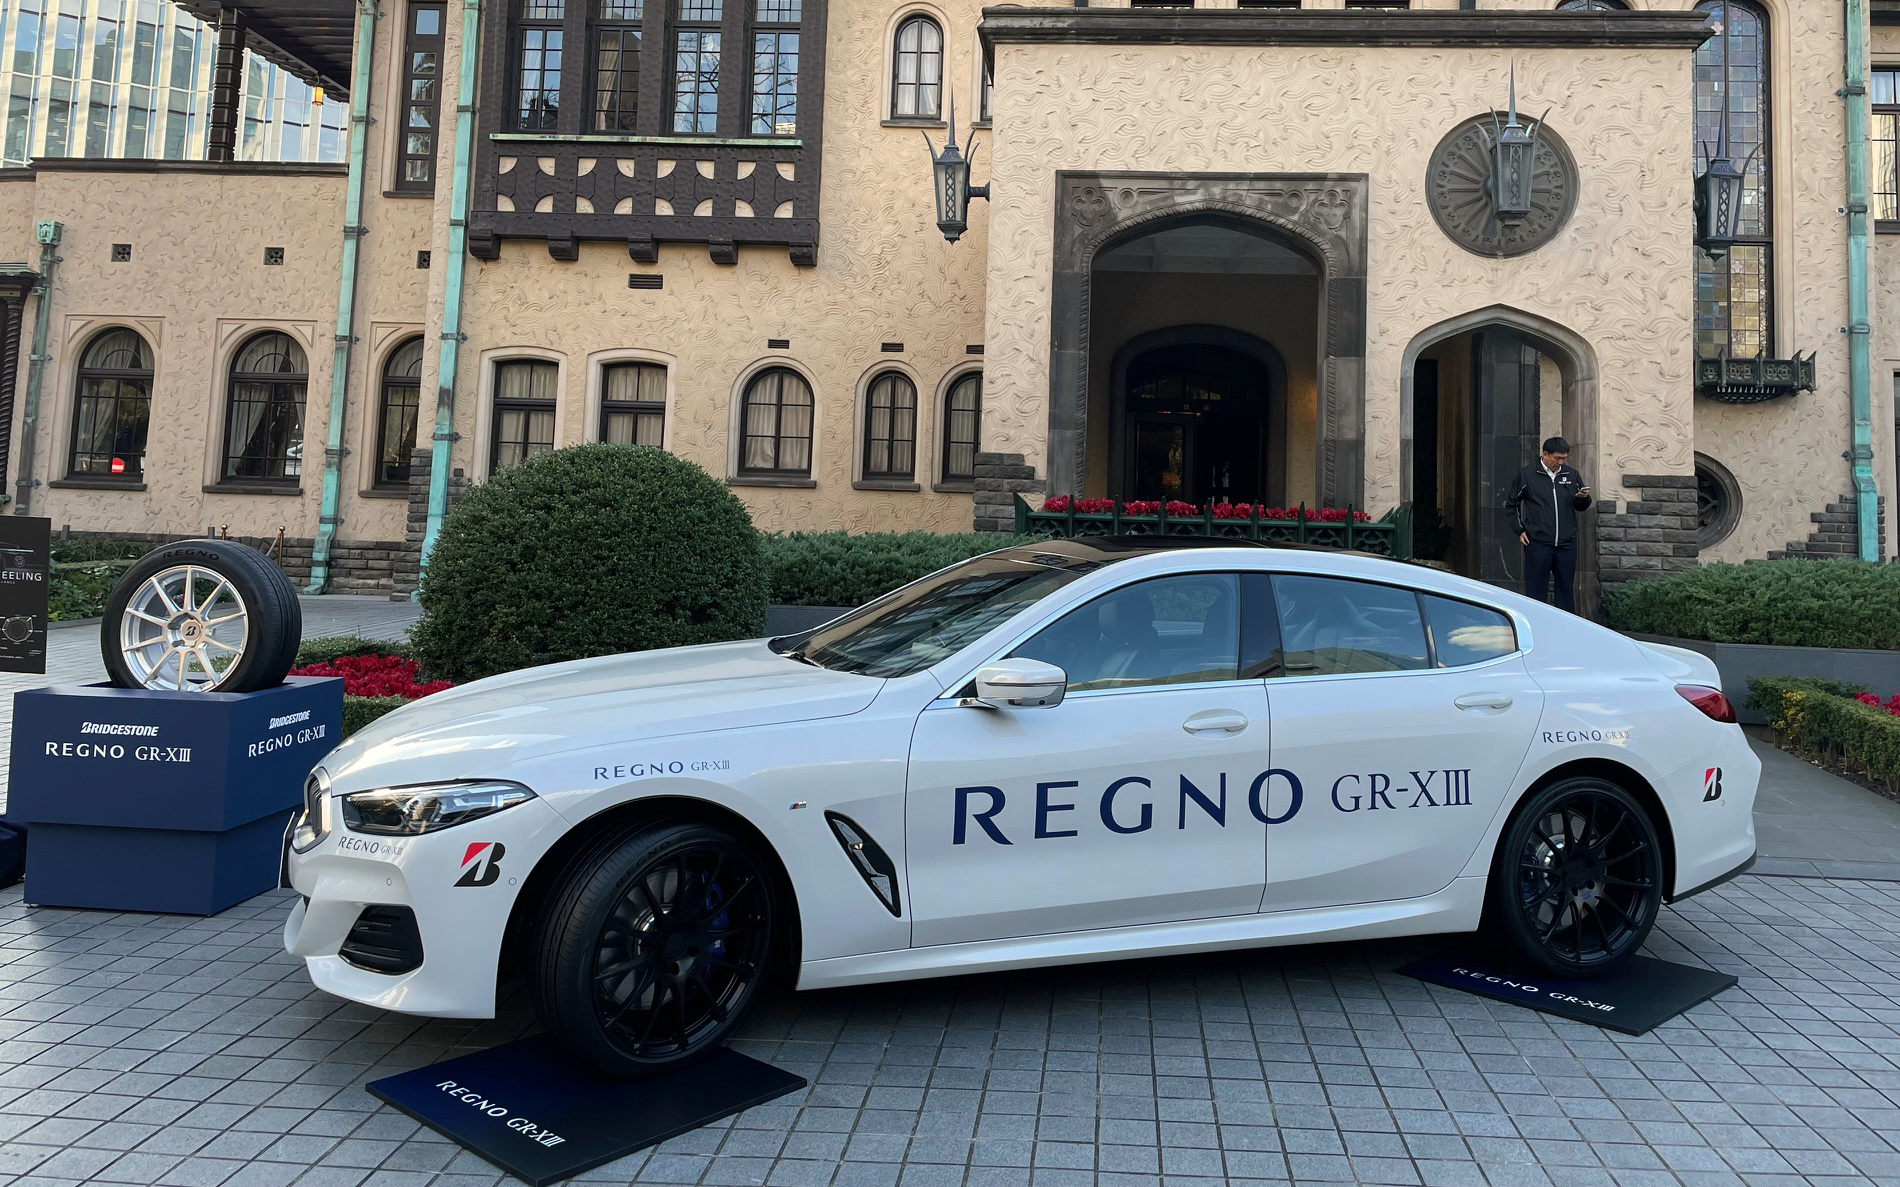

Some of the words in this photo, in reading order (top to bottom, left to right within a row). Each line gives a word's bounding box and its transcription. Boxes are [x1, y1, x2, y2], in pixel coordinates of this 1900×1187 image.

[163, 548, 219, 560] REGNO
[0, 570, 42, 582] EELING
[80, 721, 160, 737] BRIDGESTONE
[268, 709, 311, 730] BRIDGESTONE
[248, 733, 293, 758] REGNO
[1542, 729, 1602, 744] REGNO
[45, 741, 125, 759] REGNO
[594, 761, 684, 780] REGNO
[952, 768, 1304, 846] REGNO
[337, 836, 380, 854] REGNO
[616, 841, 670, 889] REGNO
[1452, 967, 1539, 993] REGNO
[436, 1080, 508, 1117] REGNO
